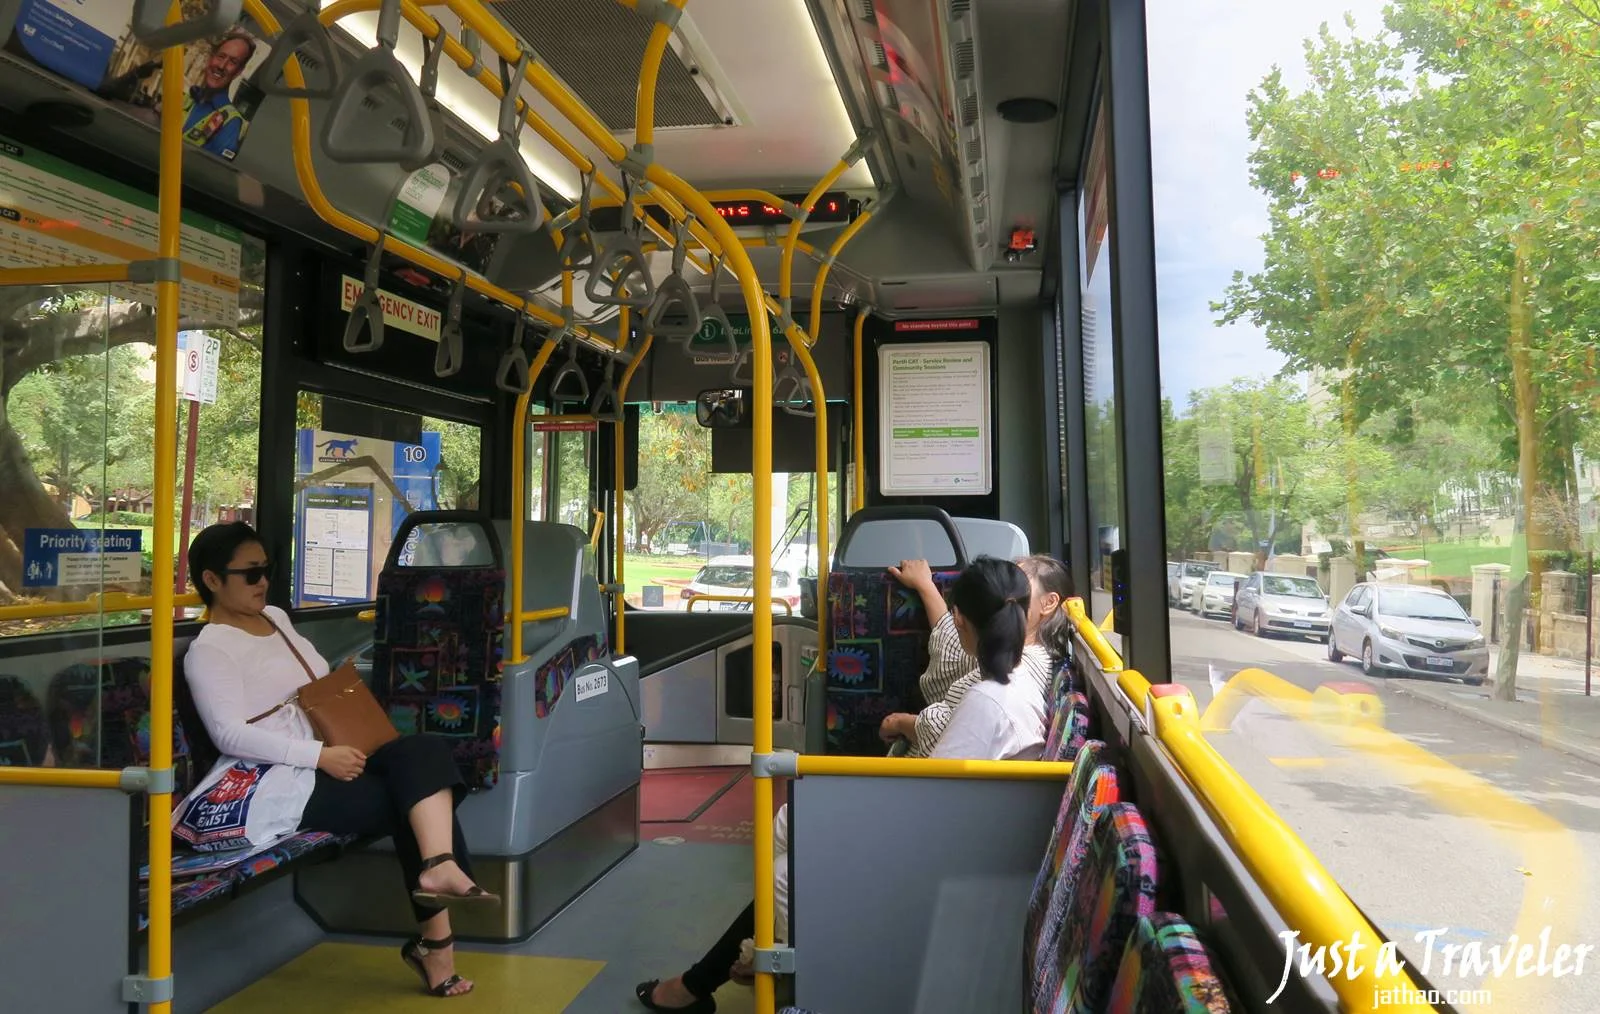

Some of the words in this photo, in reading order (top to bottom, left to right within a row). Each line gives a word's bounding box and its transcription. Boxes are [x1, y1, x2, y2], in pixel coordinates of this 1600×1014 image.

[344, 282, 414, 321] EMGENCY
[416, 310, 439, 331] EXIT
[205, 339, 219, 355] 2P
[403, 445, 427, 463] 10
[40, 534, 87, 551] Priority
[90, 534, 132, 550] seating
[577, 683, 586, 695] Bus
